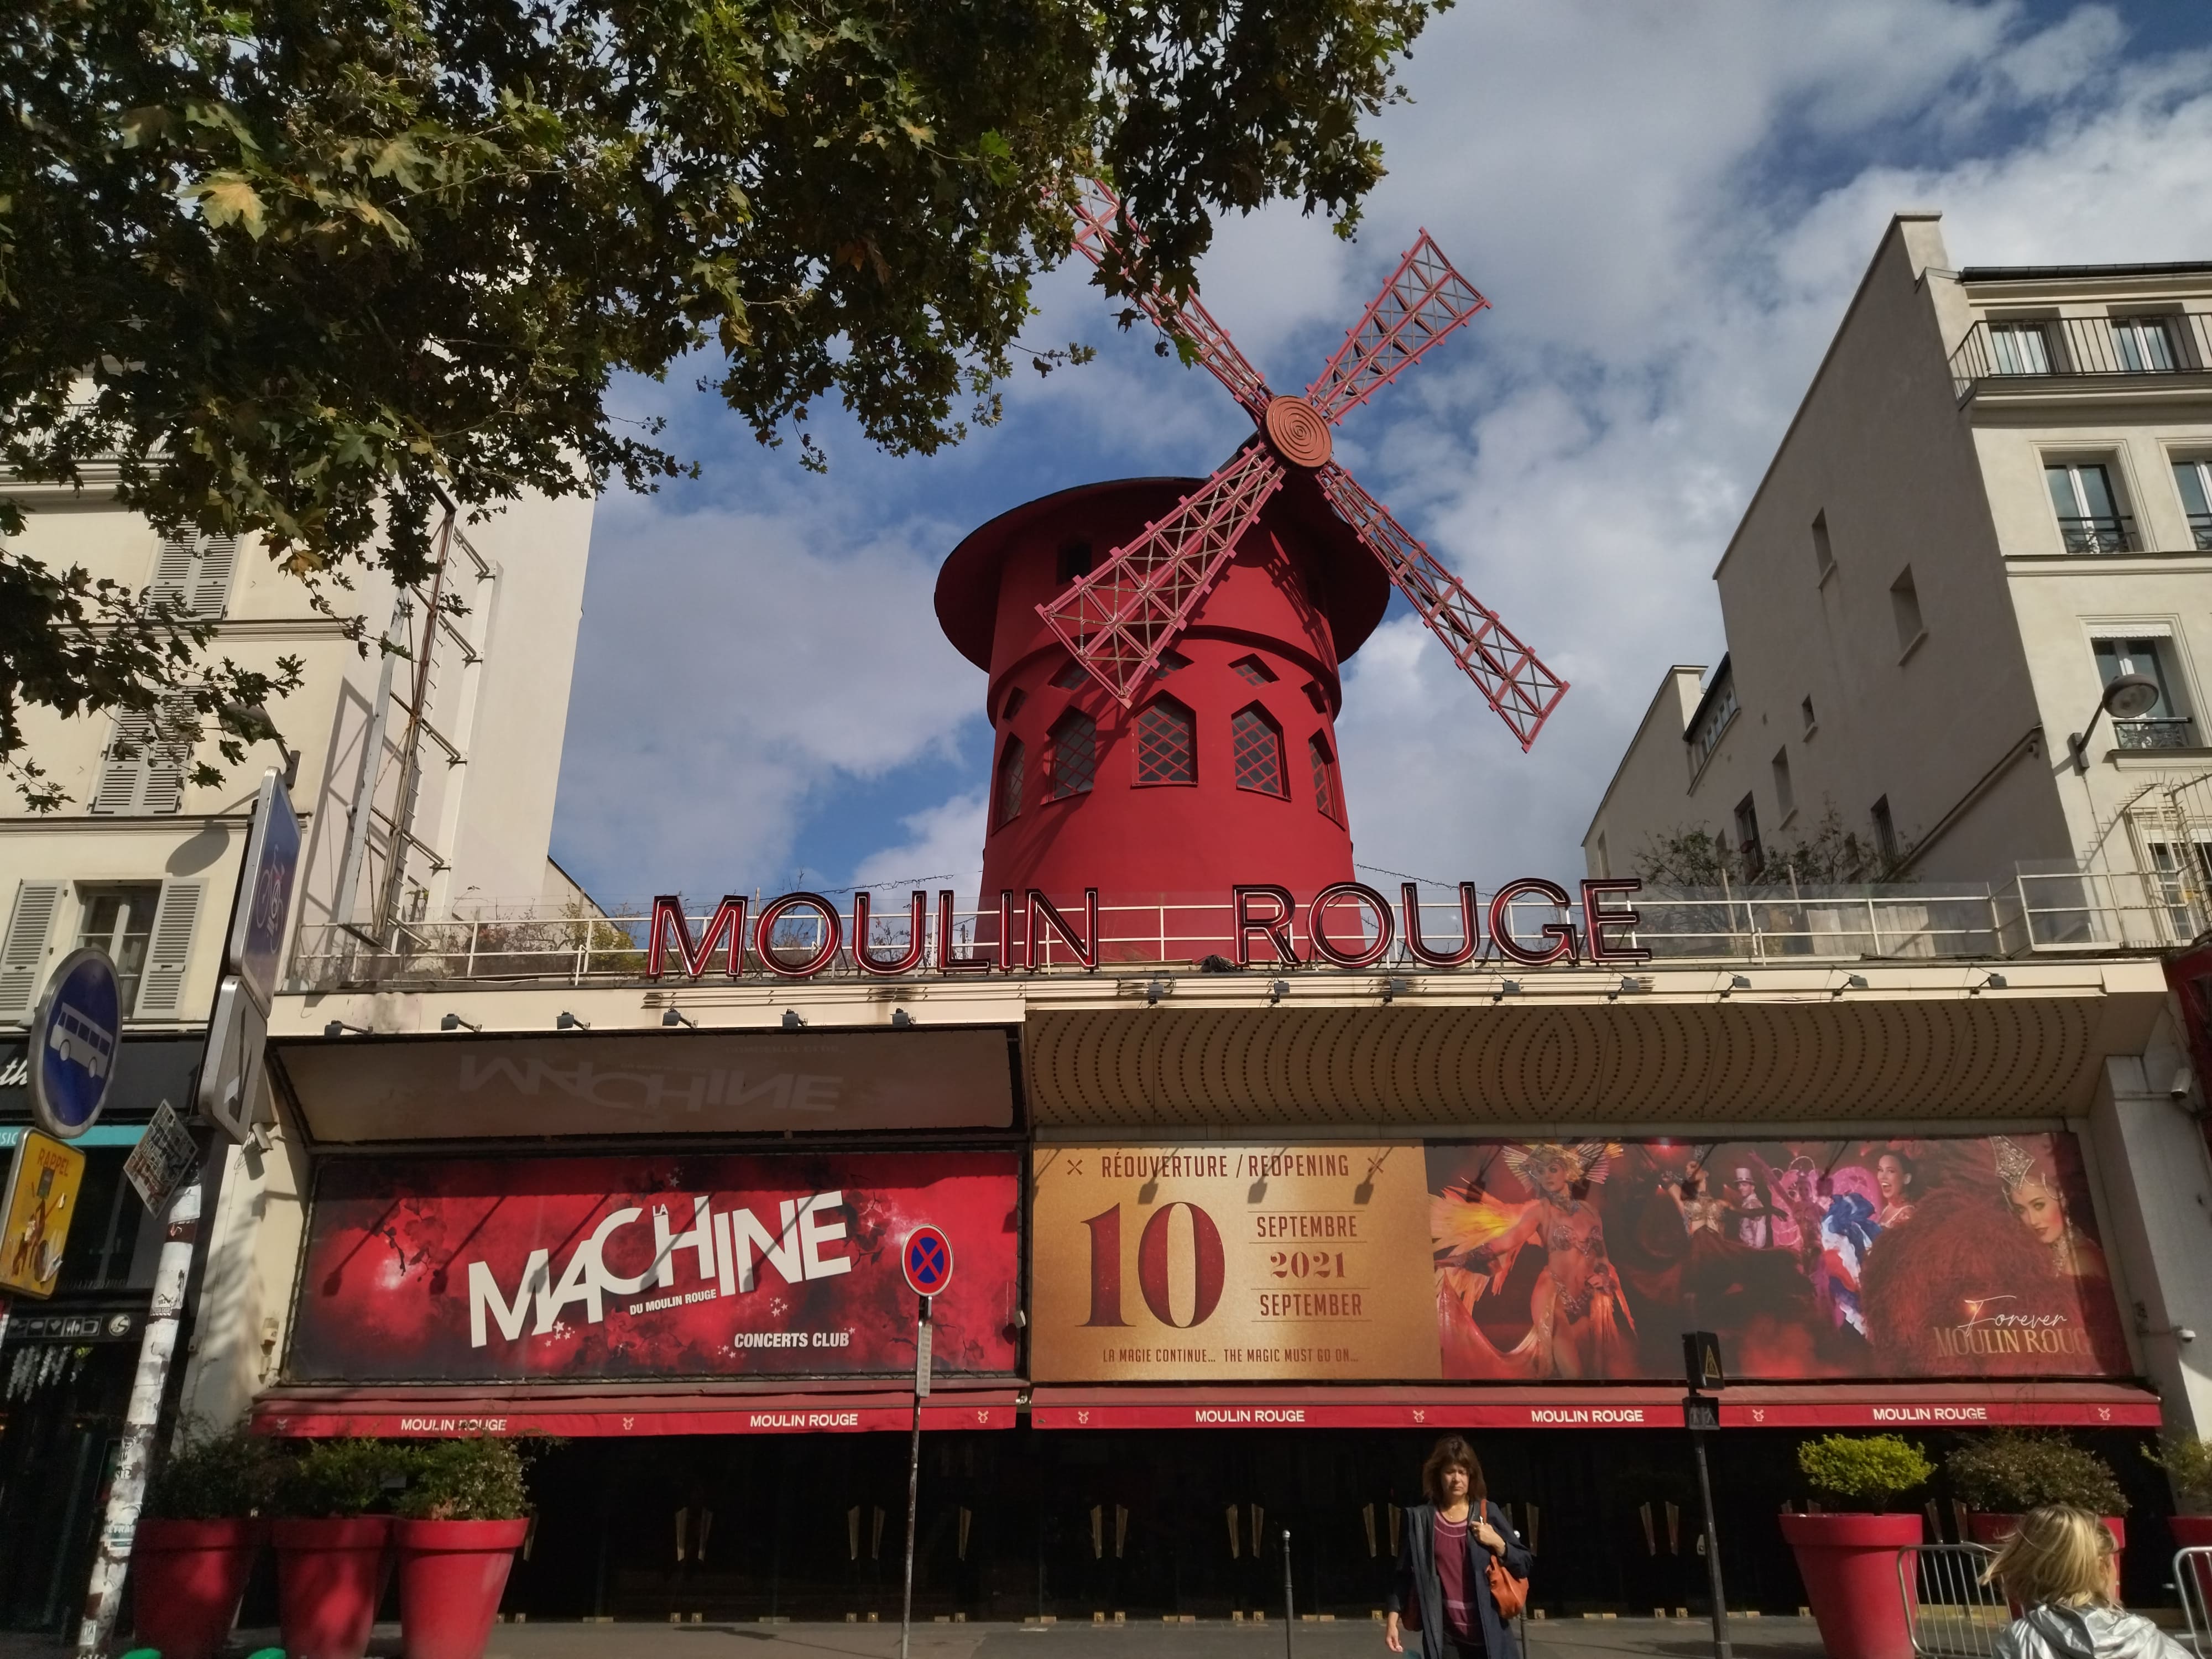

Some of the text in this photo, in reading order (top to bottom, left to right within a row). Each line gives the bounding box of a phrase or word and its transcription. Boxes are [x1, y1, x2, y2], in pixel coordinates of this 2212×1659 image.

[646, 878, 1652, 979] MOULIN ROUGE
[37, 1147, 70, 1177] RAPPEL
[1101, 1151, 1228, 1178] RÉOUVERTURE
[1249, 1154, 1349, 1177] REOPENING
[652, 1203, 669, 1216] LA
[1256, 1216, 1358, 1238] SEPTEMBRE
[469, 1191, 852, 1348] MACHINE
[1075, 1201, 1225, 1328] 10
[1270, 1251, 1346, 1279] 2021
[629, 1288, 717, 1316] DU MOULIN ROUGE
[1260, 1293, 1362, 1317] SEPTEMBER
[734, 1333, 849, 1348] CONCERTS CLUB
[1933, 1327, 2094, 1357] MOULIN ROUG
[1103, 1349, 1115, 1363] LA
[1119, 1349, 1152, 1363] MAGIE
[1224, 1348, 1243, 1363] THE
[1247, 1348, 1280, 1363] MAGIC
[1284, 1348, 1312, 1363] MUST
[1317, 1348, 1331, 1363] GO
[401, 1418, 455, 1431] MOULIN
[750, 1413, 858, 1427] MOULIN ROUGE
[1195, 1410, 1305, 1423] MOULIN ROUGE
[1531, 1410, 1644, 1423] MOULIN ROUGE
[1872, 1407, 1987, 1421] MOULIN ROUGE
